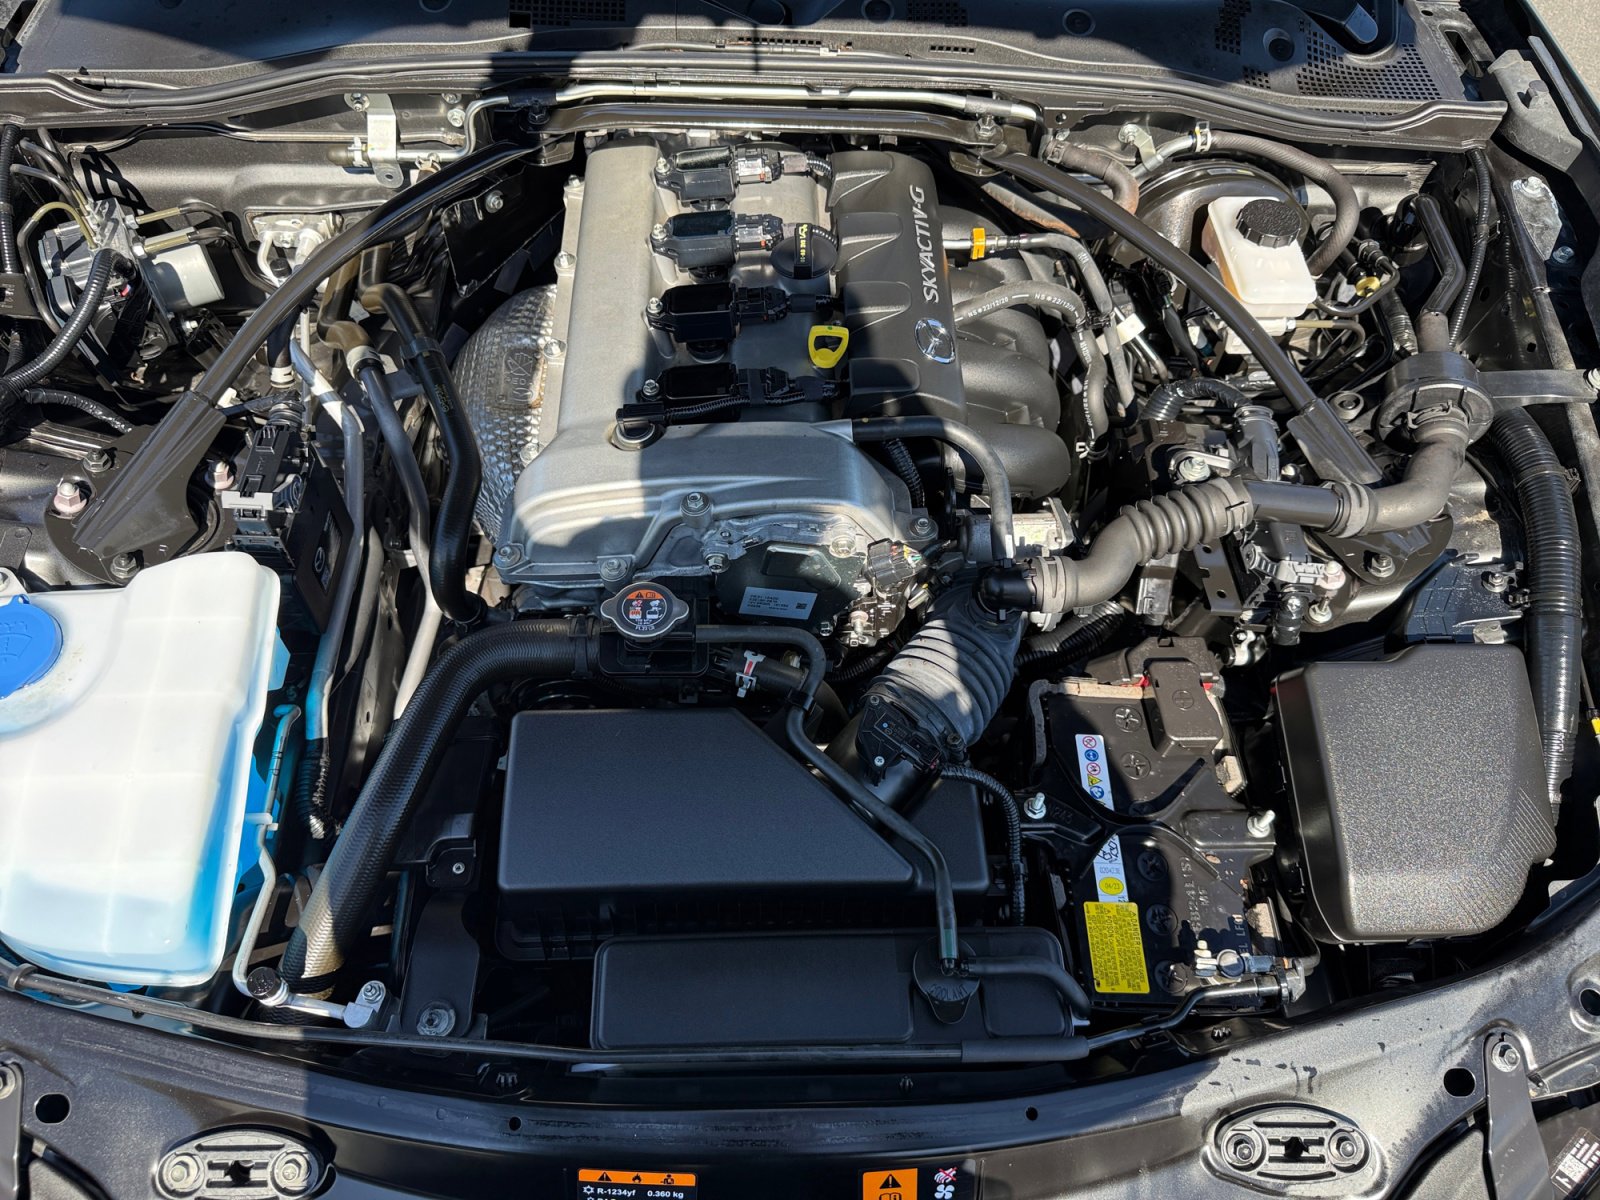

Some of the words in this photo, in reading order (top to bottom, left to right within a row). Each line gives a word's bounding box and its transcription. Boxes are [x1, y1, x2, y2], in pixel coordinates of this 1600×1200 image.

[909, 184, 939, 304] SKYACTIV-G
[1105, 916, 1115, 938] POISON
[1130, 919, 1140, 945] DANGER
[596, 1187, 637, 1197] R-1234yf
[672, 1191, 684, 1199] kg
